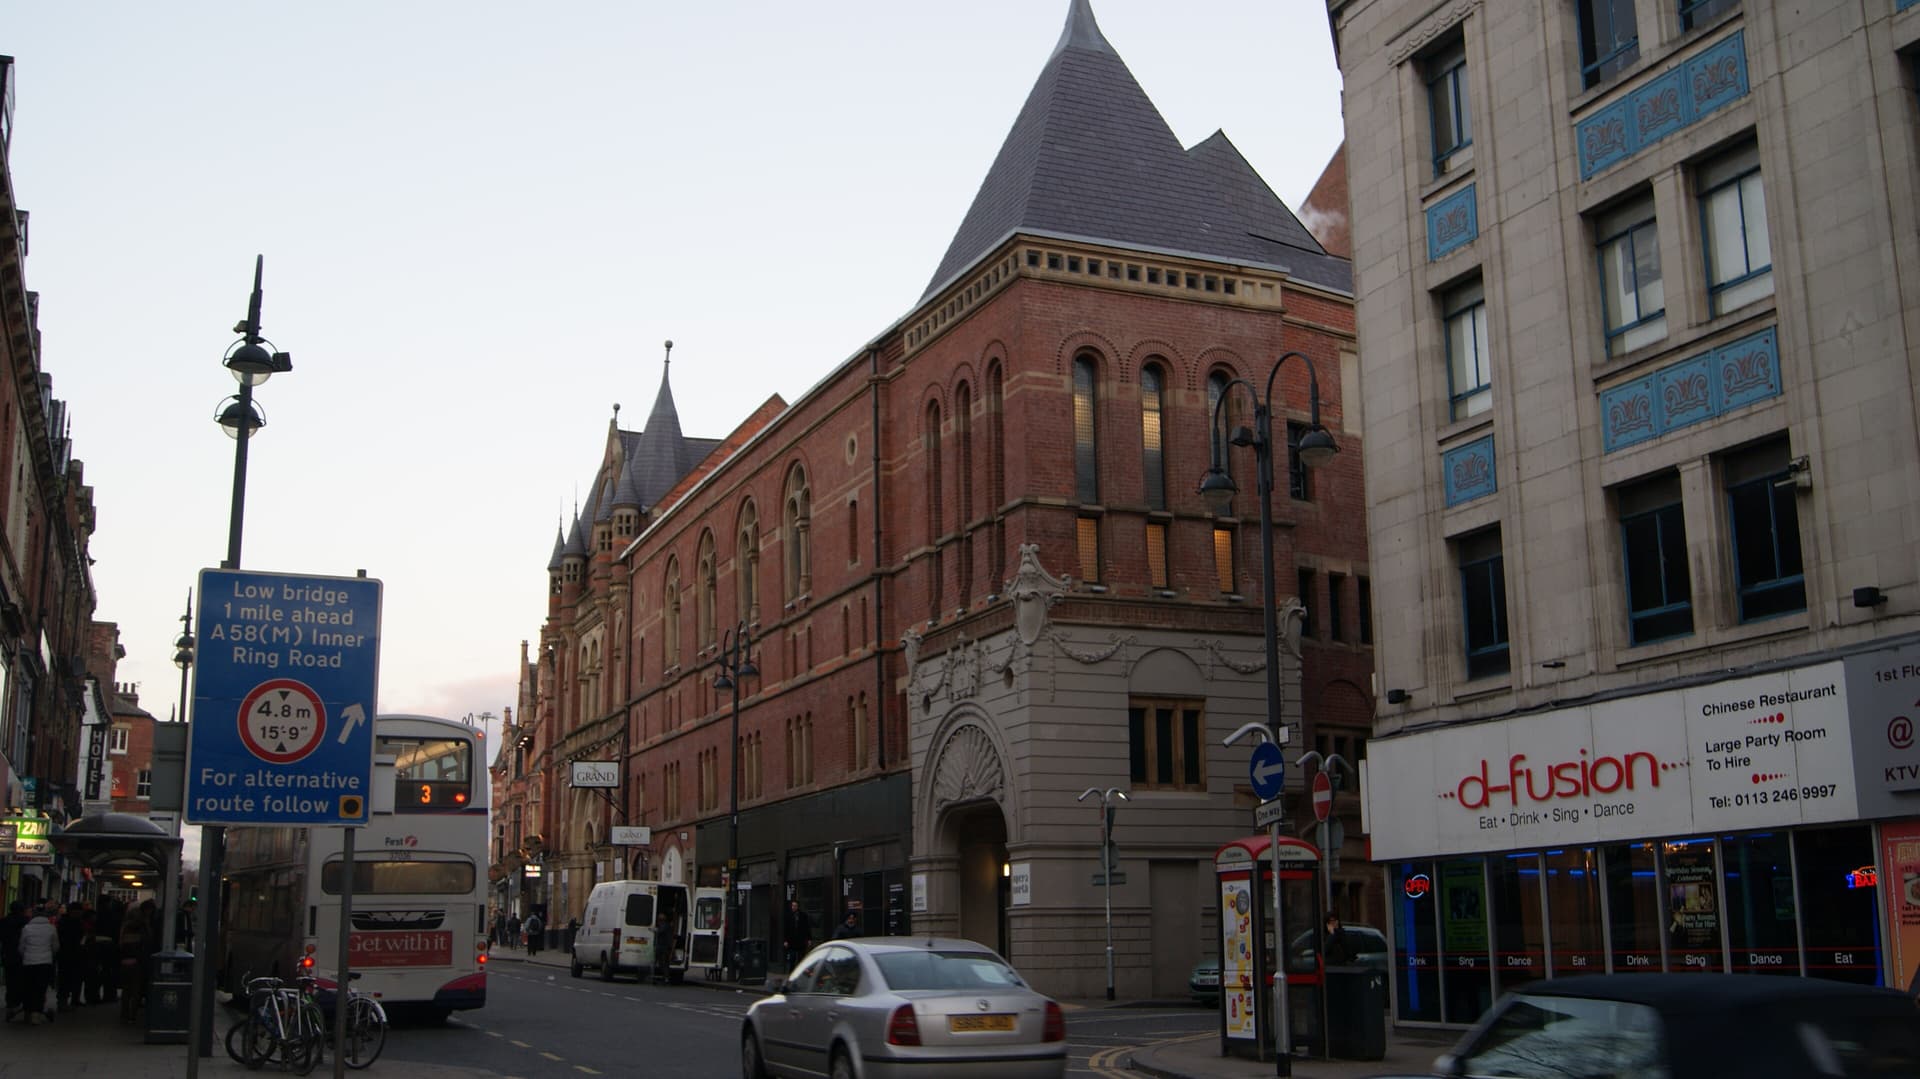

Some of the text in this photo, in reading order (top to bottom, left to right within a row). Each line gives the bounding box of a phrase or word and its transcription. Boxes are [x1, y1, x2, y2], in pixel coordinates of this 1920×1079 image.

[233, 581, 349, 606] Low bridge
[224, 603, 354, 625] 1 mile ahead
[312, 627, 364, 647] Inner
[233, 647, 342, 669] Ring Road
[1875, 668, 1898, 682] 1st
[1702, 684, 1837, 717] Chinese Restaurant
[1705, 727, 1827, 753] Large Party Room
[88, 730, 103, 796] HOTEL
[1706, 755, 1751, 771] To Hire
[201, 768, 360, 789] For alternative
[576, 772, 615, 782] GRAND
[1458, 748, 1660, 809] d-fusion
[1885, 764, 1920, 783] KTV
[420, 784, 432, 804] 3
[1710, 784, 1837, 809] Tel: 0113 246 9997
[196, 794, 329, 814] route follow
[1479, 802, 1635, 830] Eat Drink Sing Dance
[385, 836, 404, 846] First
[1404, 877, 1431, 894] OPEN
[349, 933, 448, 952] Get with it
[1409, 955, 1426, 966] Drink
[1458, 956, 1475, 967] Sing
[1507, 955, 1532, 966] Dance
[1572, 955, 1587, 966] Eat
[1626, 955, 1650, 966] Drink
[1685, 954, 1706, 967] Sing
[1749, 952, 1783, 966] Dance
[1834, 952, 1854, 965] Eat
